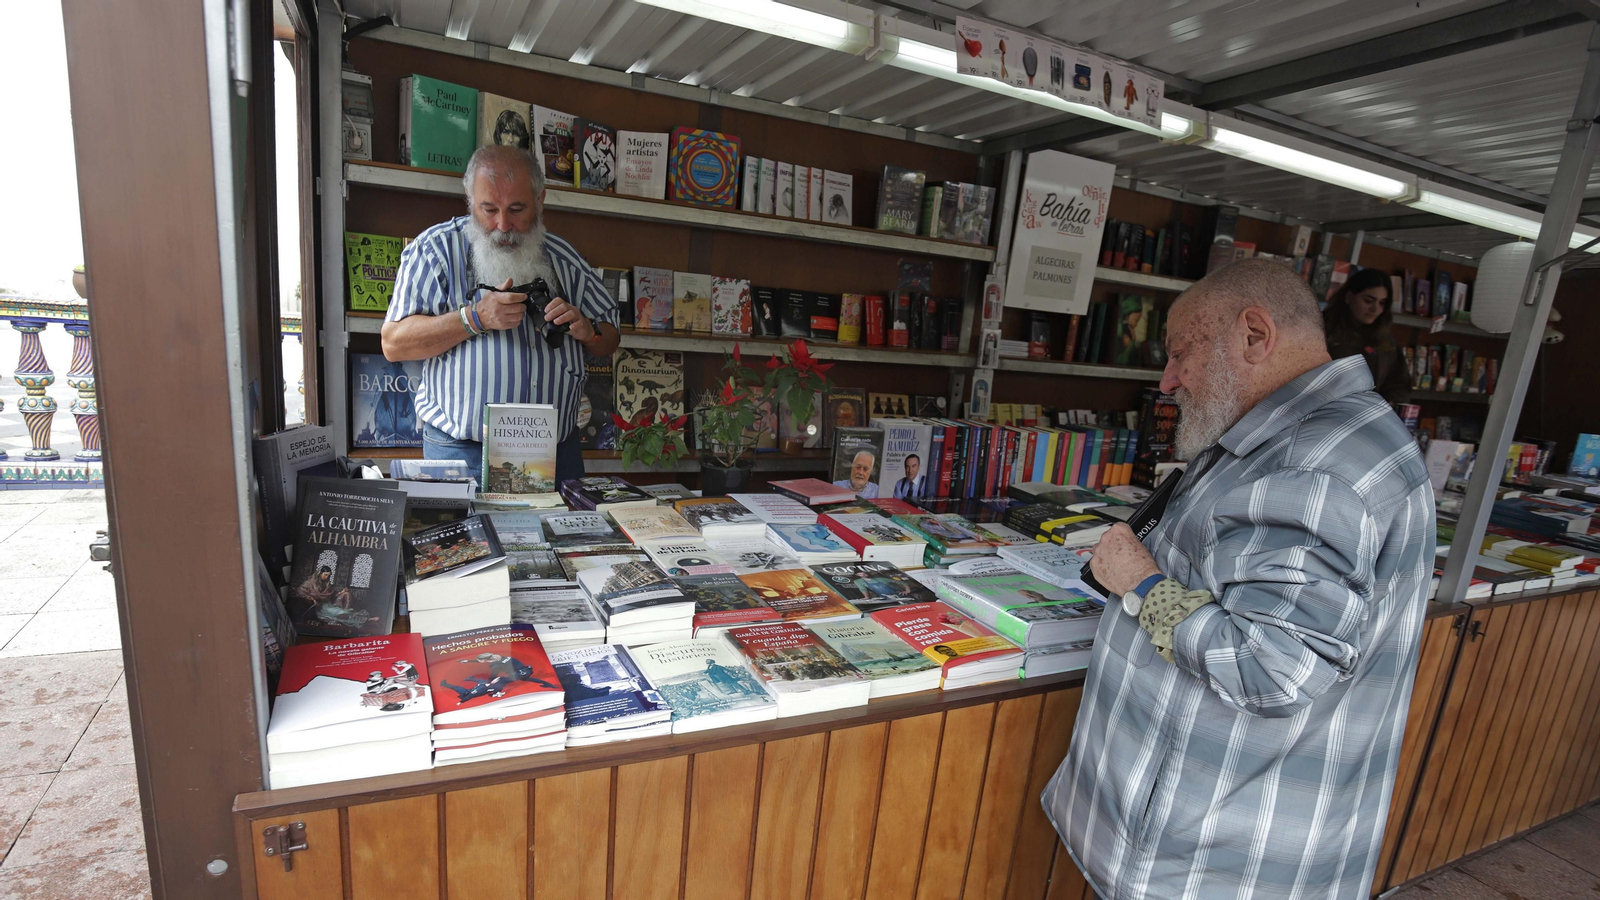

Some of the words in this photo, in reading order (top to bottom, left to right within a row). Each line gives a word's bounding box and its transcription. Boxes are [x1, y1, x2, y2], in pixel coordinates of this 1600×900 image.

[436, 88, 457, 102] Paul
[421, 95, 472, 116] McCartney
[627, 138, 662, 148] Mujeres
[626, 148, 659, 157] artistas
[427, 152, 462, 167] LETRAS
[626, 158, 652, 167] Ensayos
[886, 208, 914, 220] MARY
[1040, 193, 1092, 225] Bahía
[882, 216, 915, 230] BEARD
[1058, 218, 1084, 235] letras
[1035, 256, 1075, 269] ALGECIRAS
[1032, 271, 1072, 284] PALMONES
[586, 364, 613, 372] lanet
[621, 365, 678, 376] Dinosaurium
[498, 414, 548, 428] AMÉRICA
[494, 427, 553, 438] HISPÁNICA
[889, 428, 912, 440] PEDRO
[290, 438, 316, 451] ESPEJO
[317, 435, 327, 444] DE
[286, 451, 297, 461] LA
[299, 443, 331, 457] MEMORIA
[319, 491, 343, 499] ANTONIO
[343, 493, 380, 502] TORREMOCHA
[306, 513, 326, 529] LA
[328, 516, 388, 535] CAUTIVA
[307, 530, 389, 550] ALHAMBRA
[823, 564, 890, 574] COCINA
[894, 617, 930, 628] Pierde
[902, 622, 932, 633] grasa
[827, 625, 865, 634] Historia
[827, 630, 876, 640] Gibraltar
[914, 629, 954, 641] comida
[431, 639, 472, 651] Hechos
[474, 632, 524, 643] probados
[447, 632, 475, 640] ERNESTO
[752, 636, 787, 644] cuando
[789, 633, 809, 642] digo
[920, 636, 943, 646] real
[323, 640, 391, 652] Barbarita
[450, 642, 490, 652] SANGRE
[763, 639, 799, 648] España
[575, 650, 613, 659] FUIMOS
[649, 647, 717, 660] Discursos
